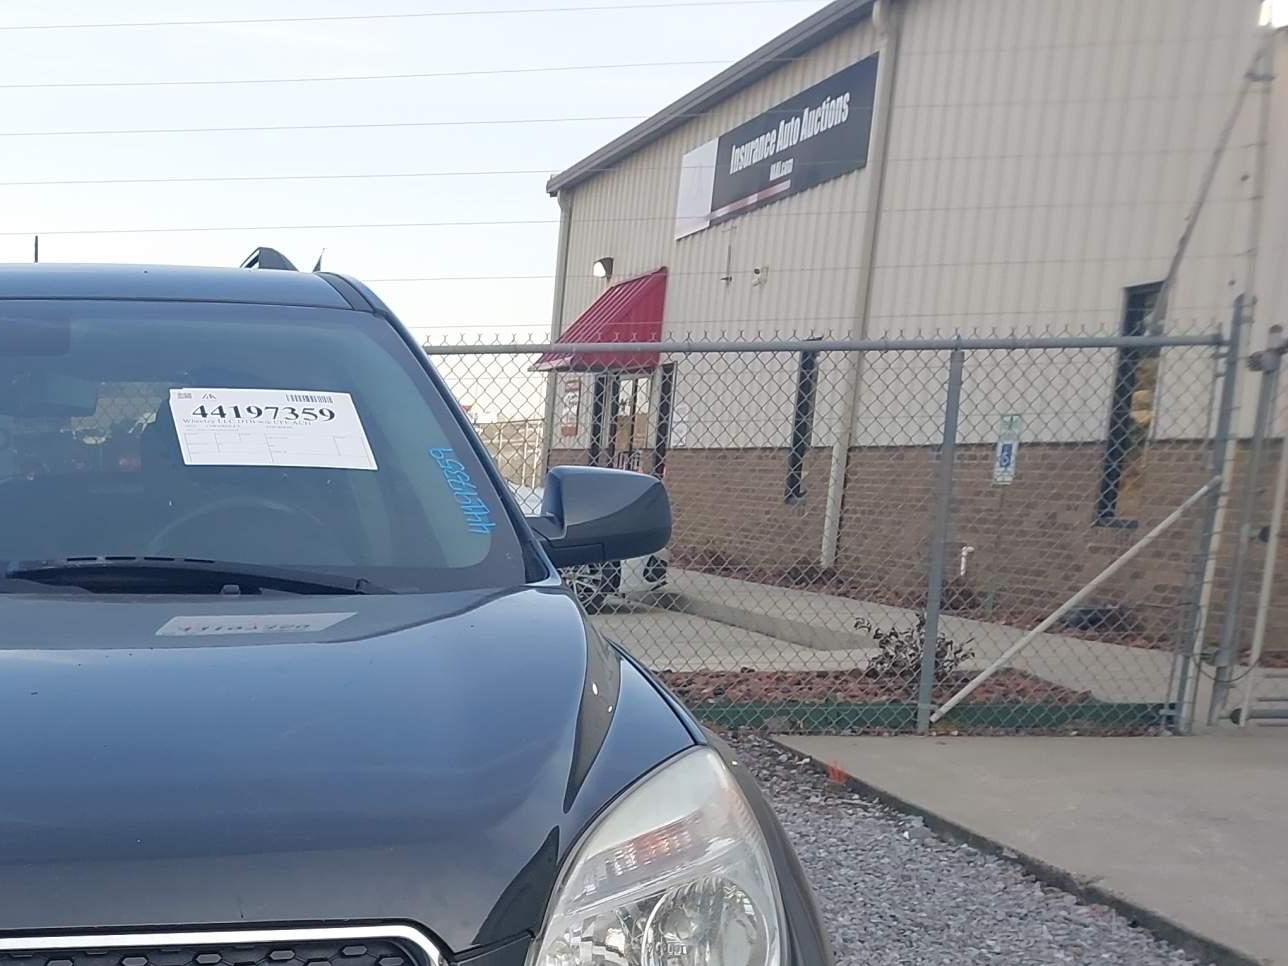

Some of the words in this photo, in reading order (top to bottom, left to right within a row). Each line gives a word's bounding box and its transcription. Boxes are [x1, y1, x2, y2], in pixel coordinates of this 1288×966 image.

[729, 128, 777, 175] Insurance
[775, 116, 801, 153] Auto
[799, 92, 850, 142] Auctions
[192, 404, 336, 423] 44197359
